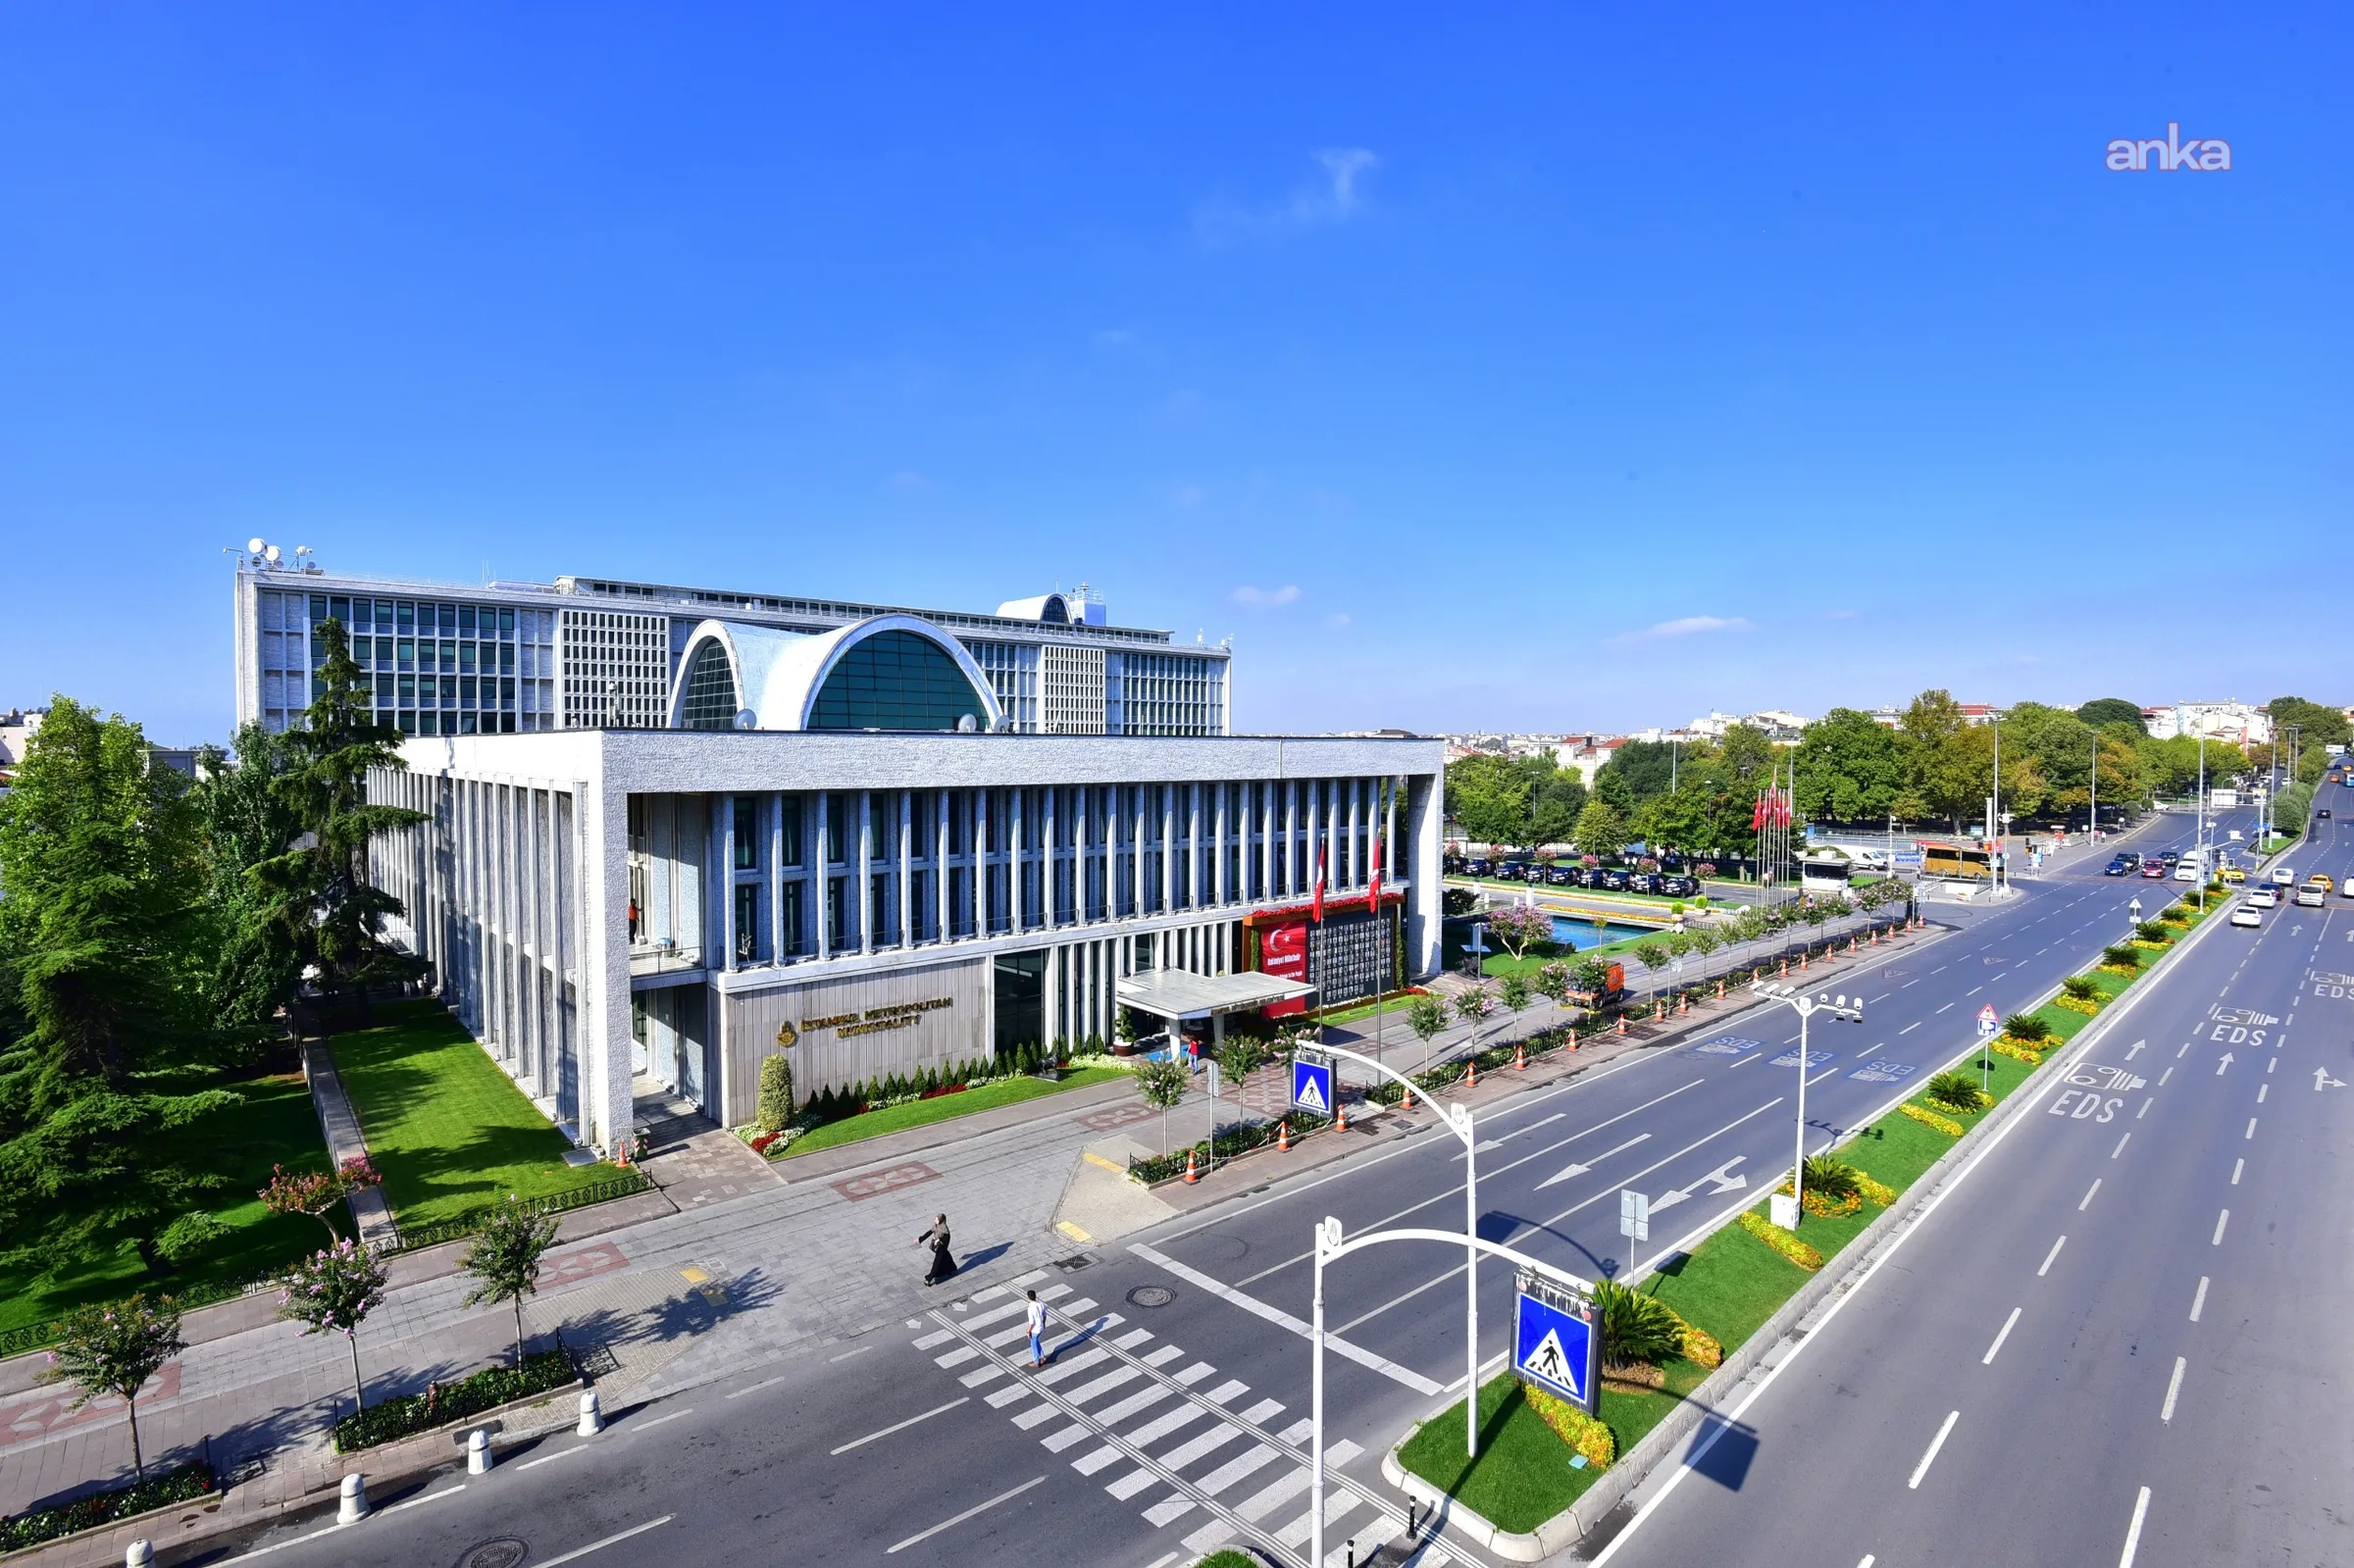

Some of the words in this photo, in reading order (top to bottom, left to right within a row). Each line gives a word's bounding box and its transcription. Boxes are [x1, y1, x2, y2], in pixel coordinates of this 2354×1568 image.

[863, 997, 953, 1021] METROPOLITAN
[837, 1014, 922, 1039] MUNICIPALITY
[2210, 1025, 2267, 1046] EDS
[1714, 1037, 1761, 1049] EDS
[1867, 1061, 1917, 1075] EDS
[2048, 1089, 2124, 1123] EDS
